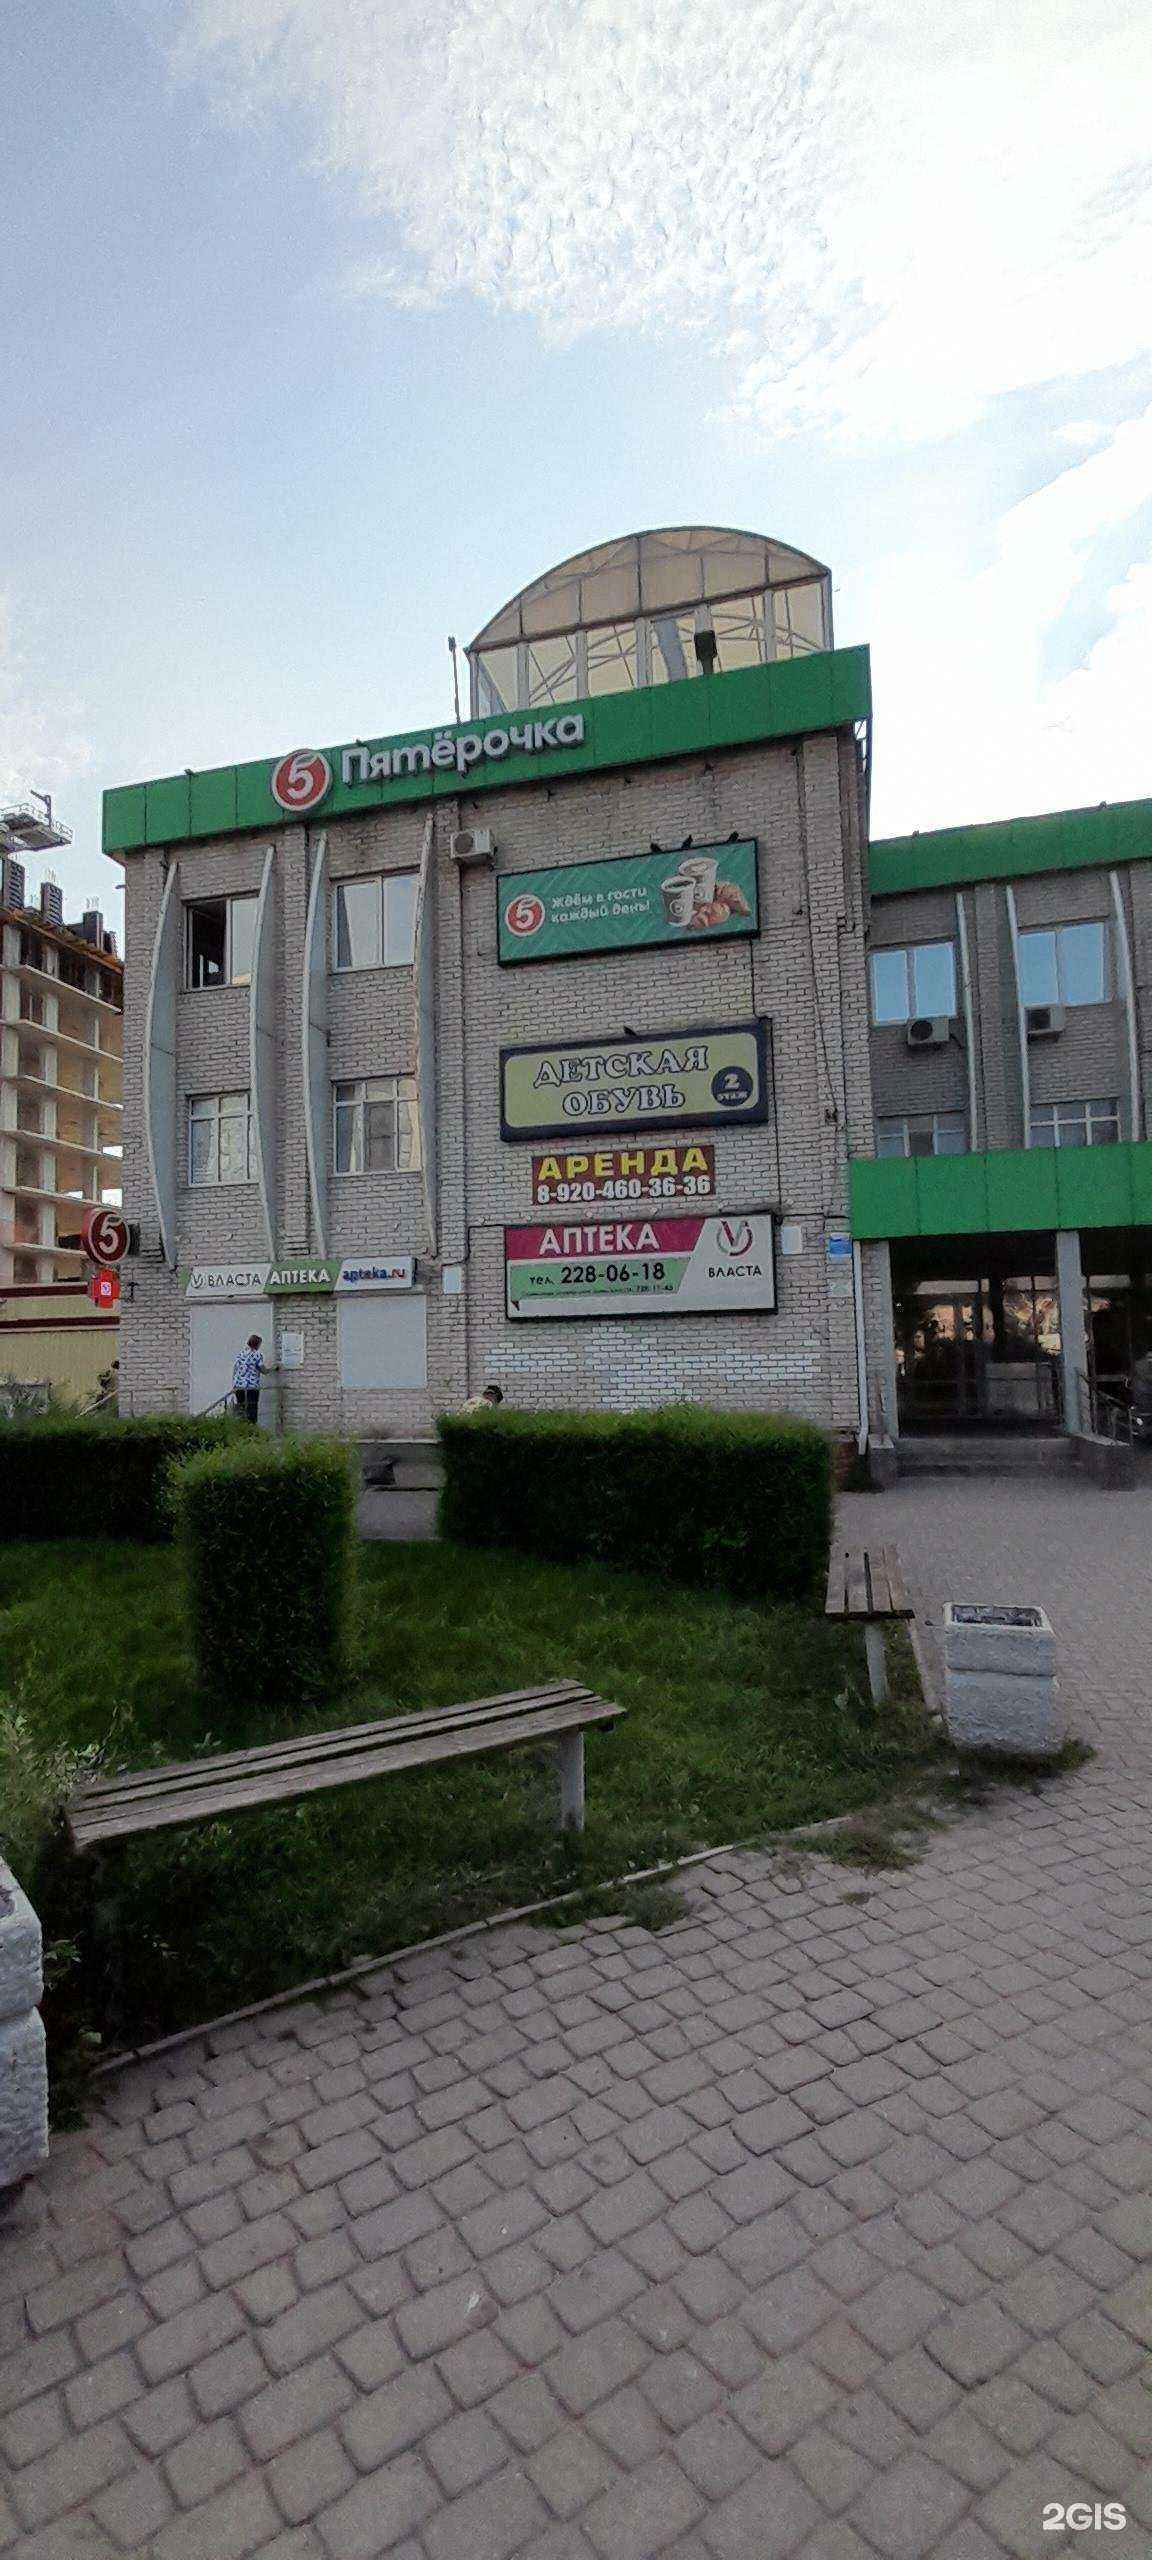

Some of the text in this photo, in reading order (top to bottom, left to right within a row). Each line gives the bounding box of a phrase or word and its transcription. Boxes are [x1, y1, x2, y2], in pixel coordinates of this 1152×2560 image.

[287, 714, 585, 799] 5 Пятёрочка
[516, 897, 536, 928] 5
[533, 1045, 709, 1089] ДЕТСКАЯ
[725, 1073, 740, 1090] 2
[562, 1083, 686, 1117] ОБУВЬ
[537, 1147, 709, 1181] АРЕНДА
[537, 1175, 711, 1205] 8-920-460-36-36
[98, 1213, 122, 1254] 5
[538, 1222, 662, 1256] АПТЕКА
[208, 1272, 261, 1288] ВЛАСТА
[269, 1268, 331, 1286] АПТЕКА
[343, 1266, 406, 1284] apteka.ru
[561, 1262, 665, 1285] 228-06-18
[708, 1264, 762, 1279] ВЛАСТА
